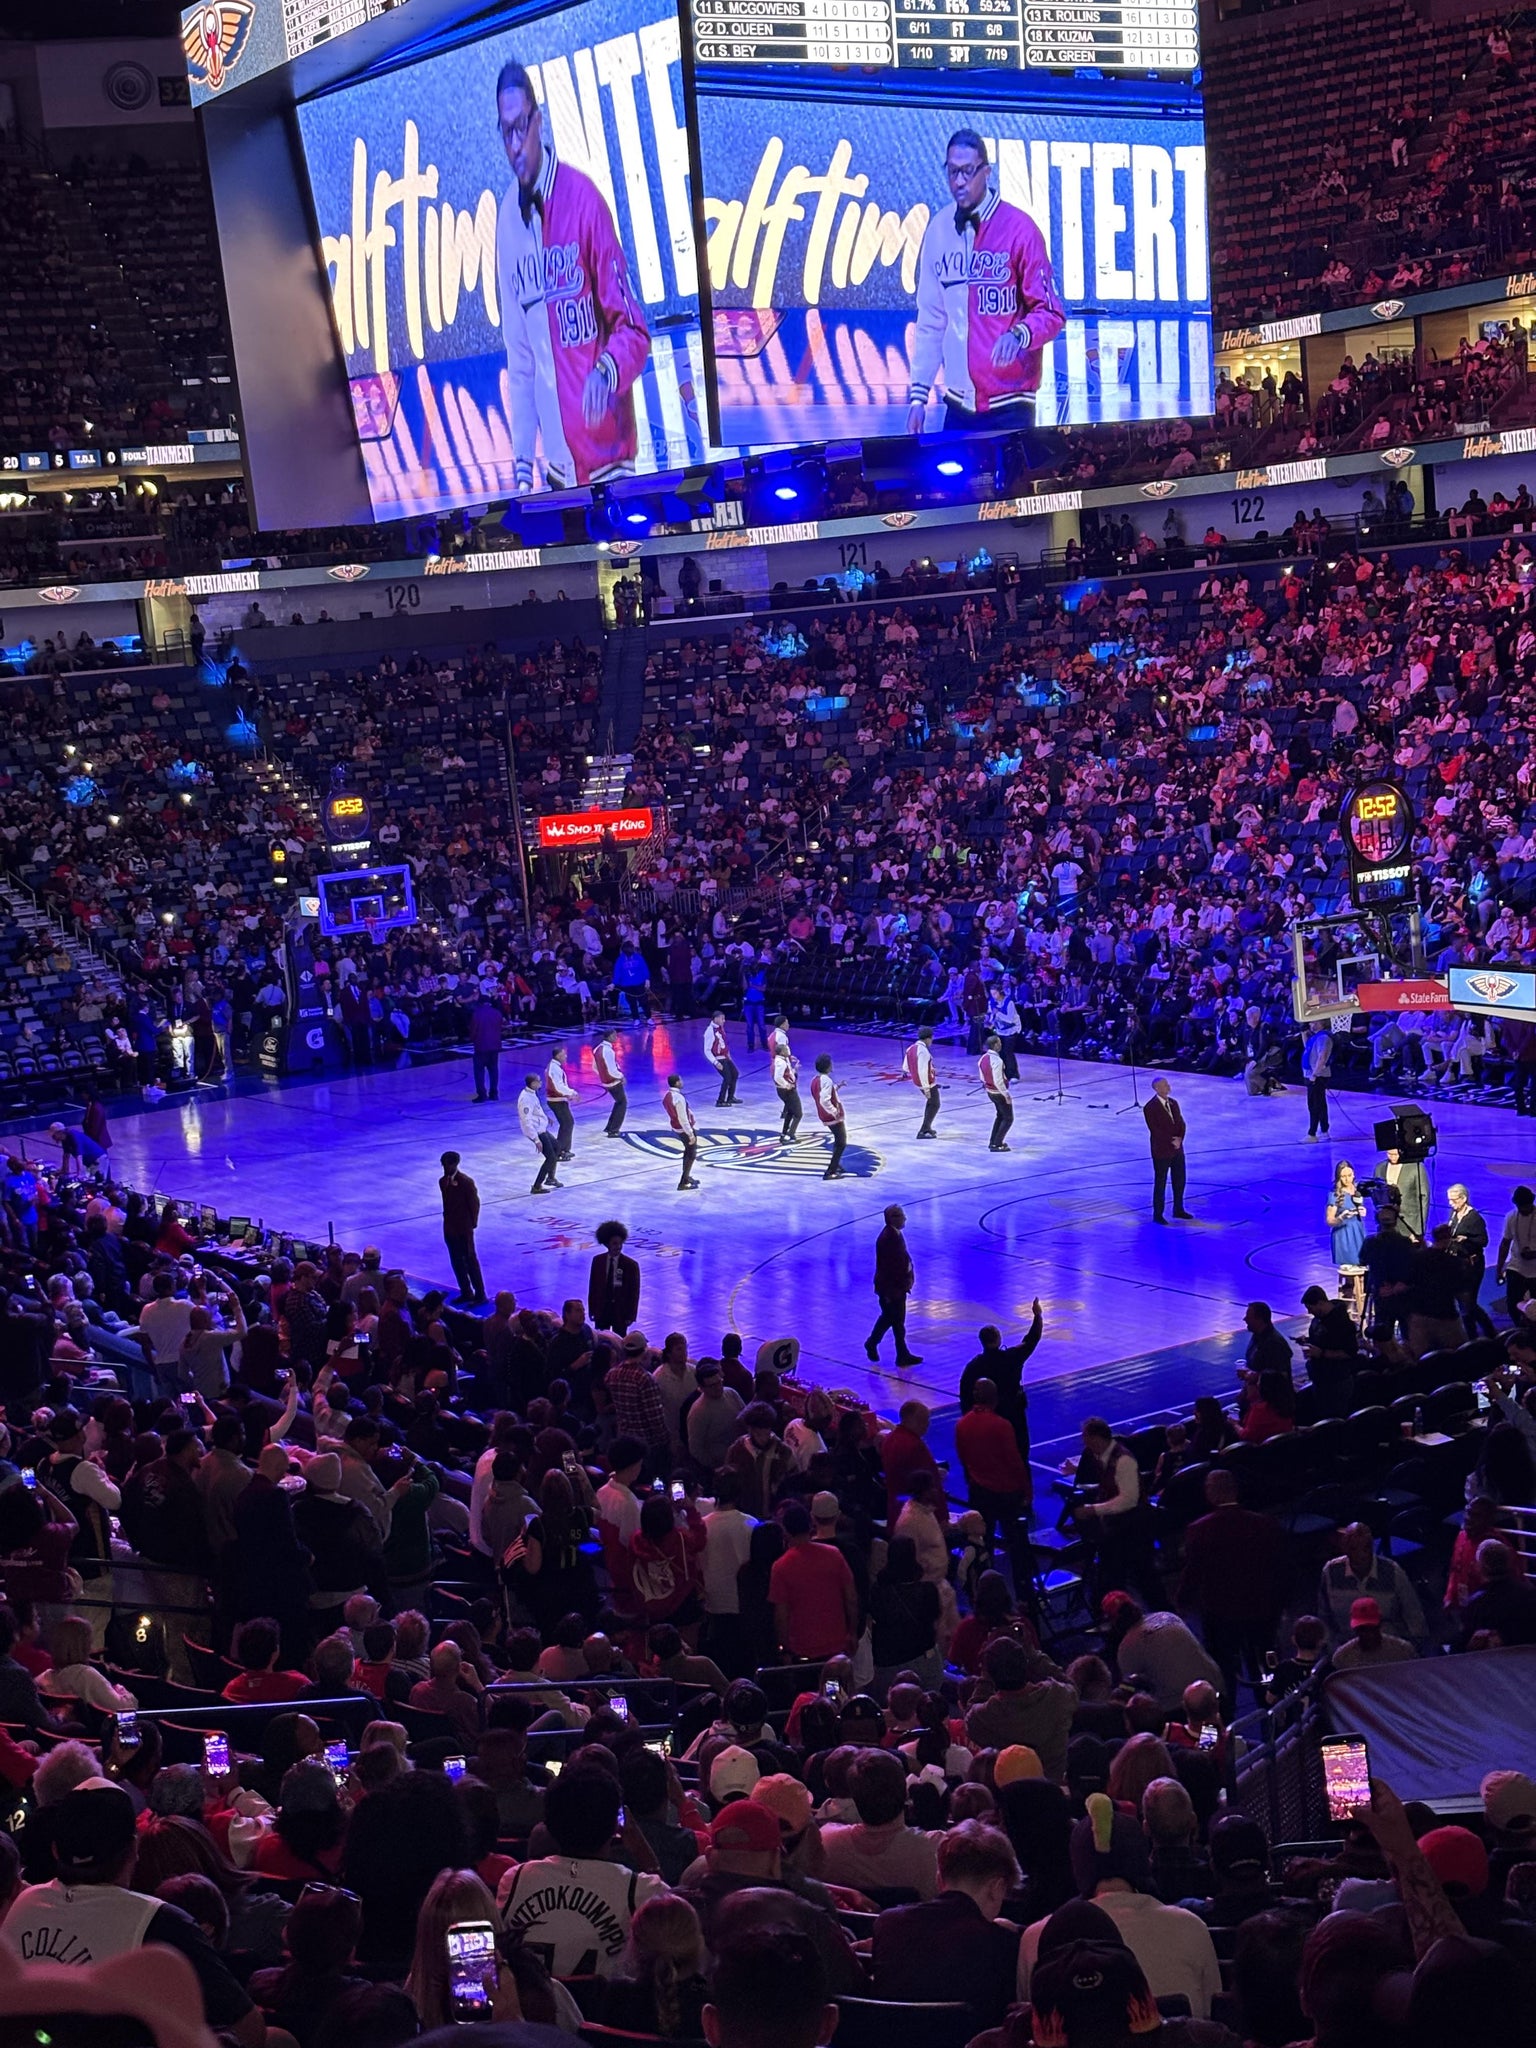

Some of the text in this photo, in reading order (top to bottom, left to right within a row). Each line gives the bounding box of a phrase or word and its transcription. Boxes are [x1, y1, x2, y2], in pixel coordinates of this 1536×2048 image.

[715, 2, 727, 15] B.
[730, 2, 801, 15] MCGOWENS
[1028, 10, 1041, 22] 13
[1056, 11, 1101, 23] ROLLINS
[1126, 12, 1137, 23] 16
[700, 23, 714, 35] 22
[716, 23, 730, 36] D.
[731, 23, 774, 36] QUEEN
[813, 26, 824, 37] 11
[909, 22, 931, 34] 6/11
[951, 21, 965, 38] FT
[986, 23, 1003, 36] 6/8
[1030, 30, 1043, 42] 18
[1057, 31, 1095, 43] KUZMA
[1127, 33, 1138, 43] 12
[701, 45, 716, 57] 41
[718, 45, 730, 57] S.
[732, 45, 757, 58] BEY
[814, 46, 825, 58] 10
[910, 46, 934, 60] 1/10
[949, 46, 970, 62] 3PT
[985, 48, 1008, 60] 7/19
[1030, 51, 1044, 62] 20
[1058, 51, 1096, 63] GREEN
[982, 138, 1208, 301] NTERT
[977, 285, 1018, 316] 1911
[556, 292, 598, 348] 1911
[1221, 313, 1322, 350] Halftime ENTERTAINMENT
[3, 456, 19, 470] 20
[28, 456, 42, 466] RB
[55, 454, 64, 468] 5
[107, 453, 116, 464] 0
[123, 451, 147, 462] FOULS
[146, 445, 195, 466] TAINMENT
[1463, 435, 1503, 459] Halftime
[1235, 458, 1327, 489] Halftime ENTERTAINMENT
[978, 490, 1083, 520] Halftime ENTERTAINMENT
[1231, 496, 1265, 524] 122
[706, 521, 818, 550] Halftime ENTERTAINMENT
[424, 548, 541, 575] Halftime ENTERTAINMENT
[838, 541, 867, 567] 121
[144, 571, 260, 599] Halftime ENTERTAINMENT
[385, 583, 421, 611] 120
[1358, 794, 1397, 819] 12:52
[1371, 865, 1411, 882] TISSOT
[1410, 991, 1449, 1004] State Farm
[306, 1027, 325, 1050] G
[773, 1342, 793, 1369] G
[136, 1628, 147, 1643] 8
[5, 1809, 26, 1833] 12
[510, 1884, 627, 1956] NTETOKOUNMPO
